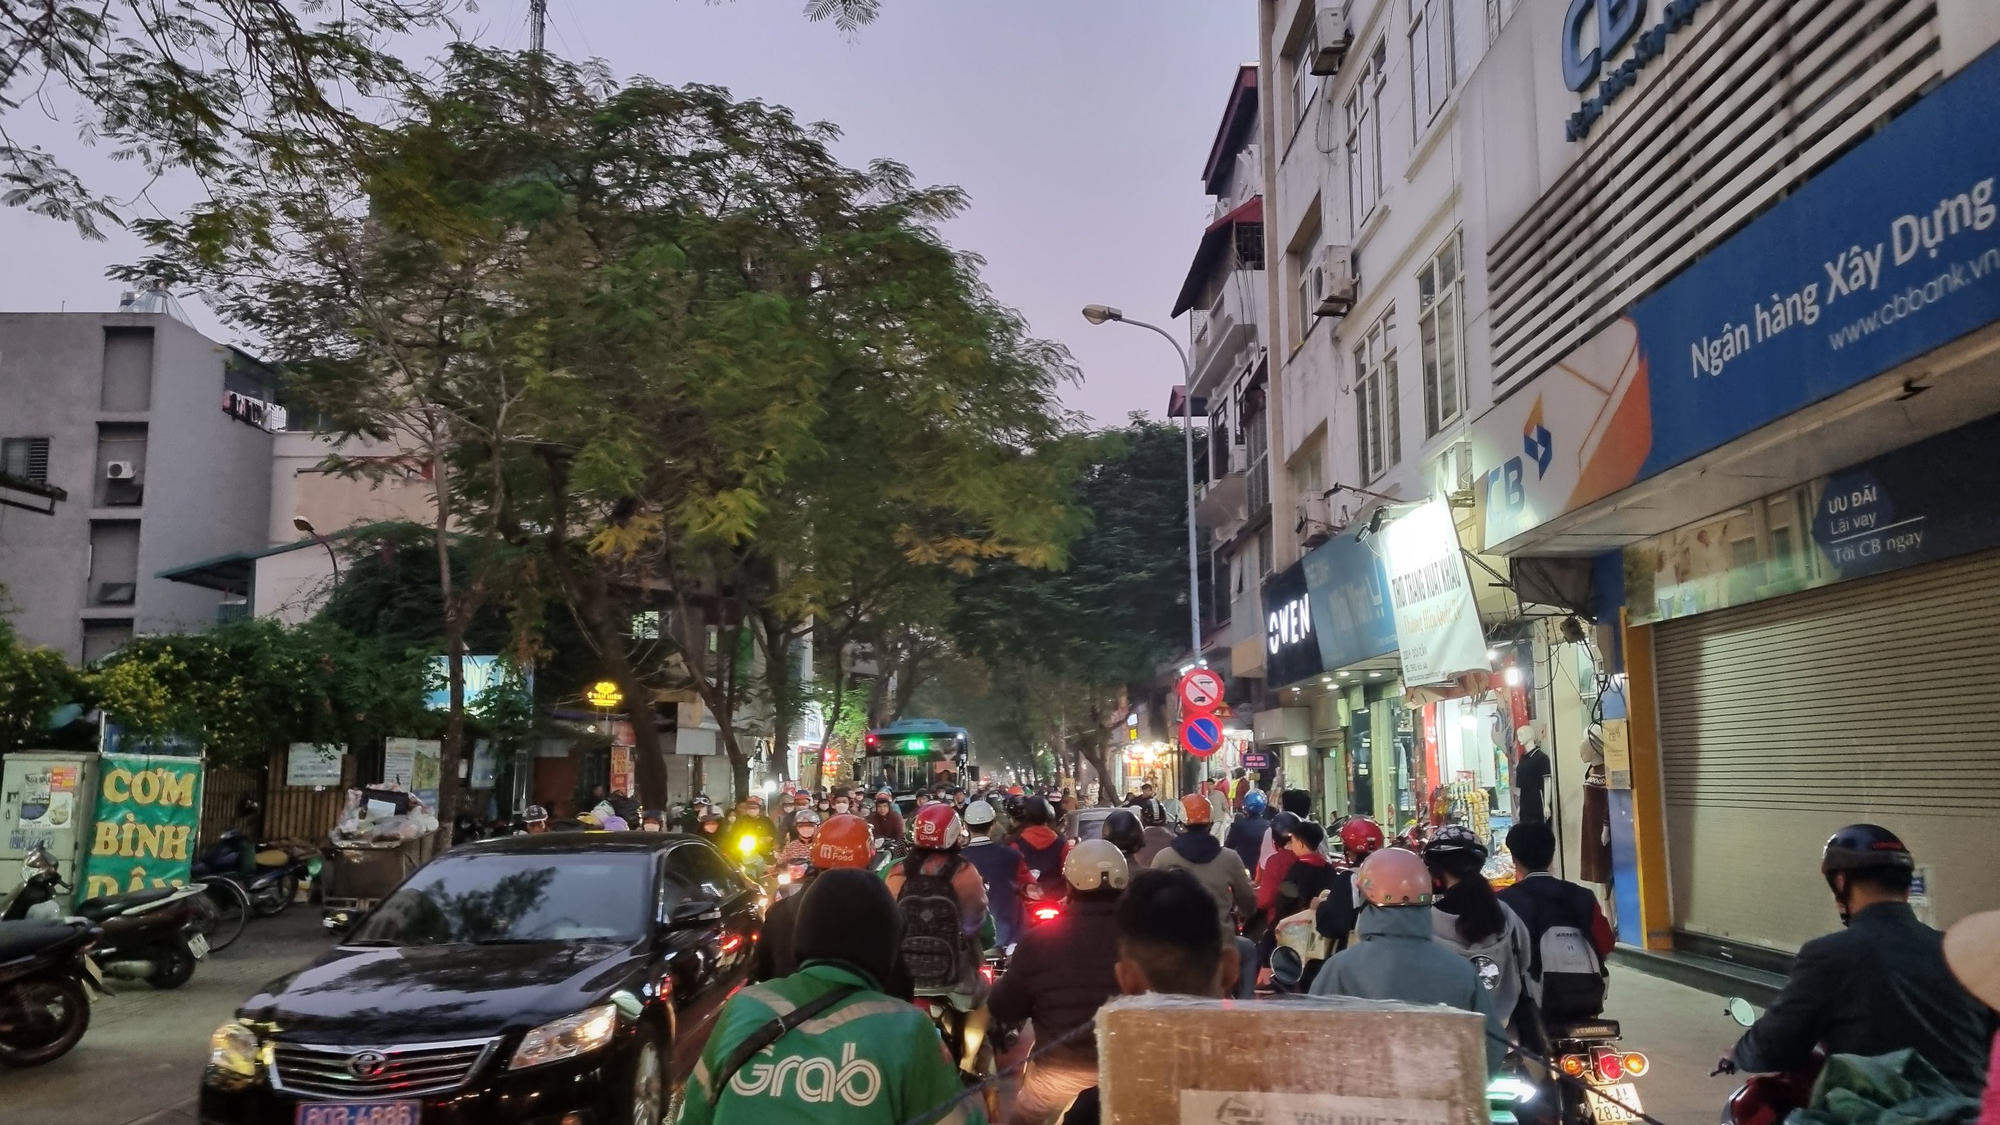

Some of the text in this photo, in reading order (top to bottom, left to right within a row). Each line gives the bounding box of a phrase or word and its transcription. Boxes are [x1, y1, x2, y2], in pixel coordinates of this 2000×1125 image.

[1691, 177, 1997, 378] Ngân hàng Xây Dựng
[1829, 248, 2000, 351] www.cbbank.vn
[1829, 484, 1877, 514] ƯU ĐÃI
[1831, 512, 1877, 535] Lãi vay
[1860, 538, 1881, 557] CB
[1886, 531, 1924, 553] ngay
[1269, 592, 1311, 655] OWEN
[103, 768, 196, 807] CƠM
[91, 812, 191, 860] BÌNH
[731, 1043, 881, 1106] Grab
